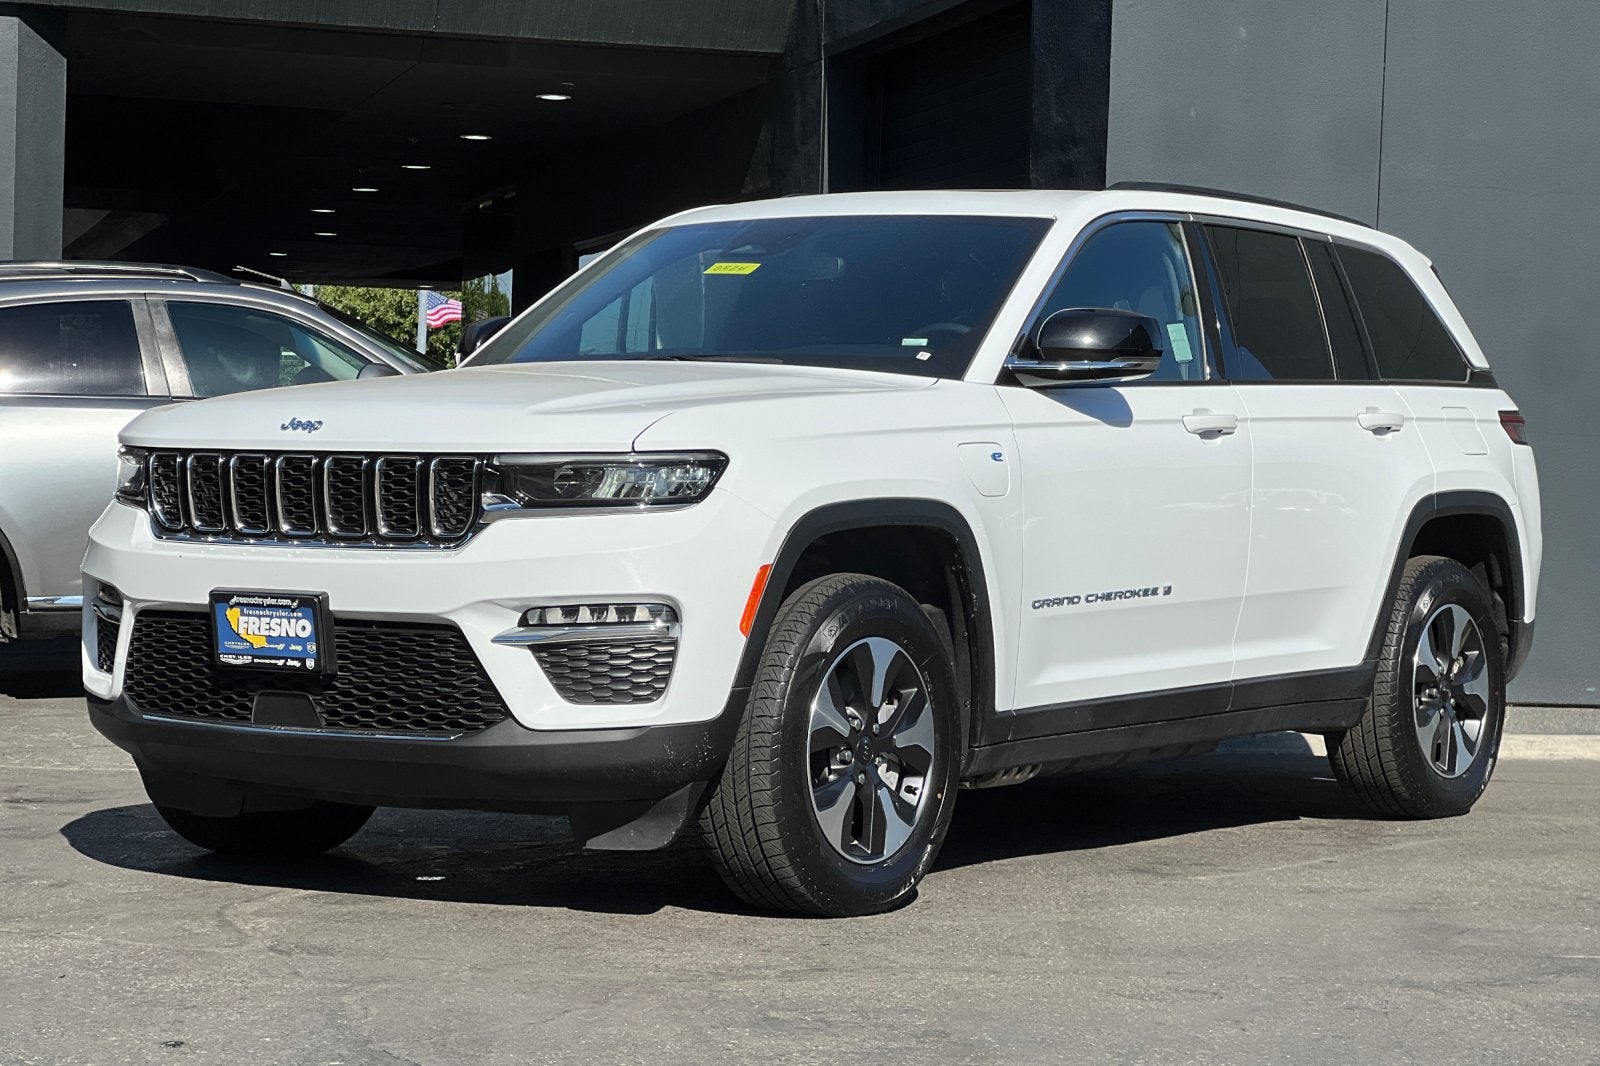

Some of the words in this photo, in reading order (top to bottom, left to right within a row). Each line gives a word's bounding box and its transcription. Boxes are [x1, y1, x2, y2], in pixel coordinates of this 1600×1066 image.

[280, 417, 323, 433] Jeep
[1031, 595, 1082, 609] GRAND
[1084, 586, 1160, 604] CHEROKEE
[243, 607, 303, 617] fresnochrysler.com
[238, 616, 312, 638] FRESNO
